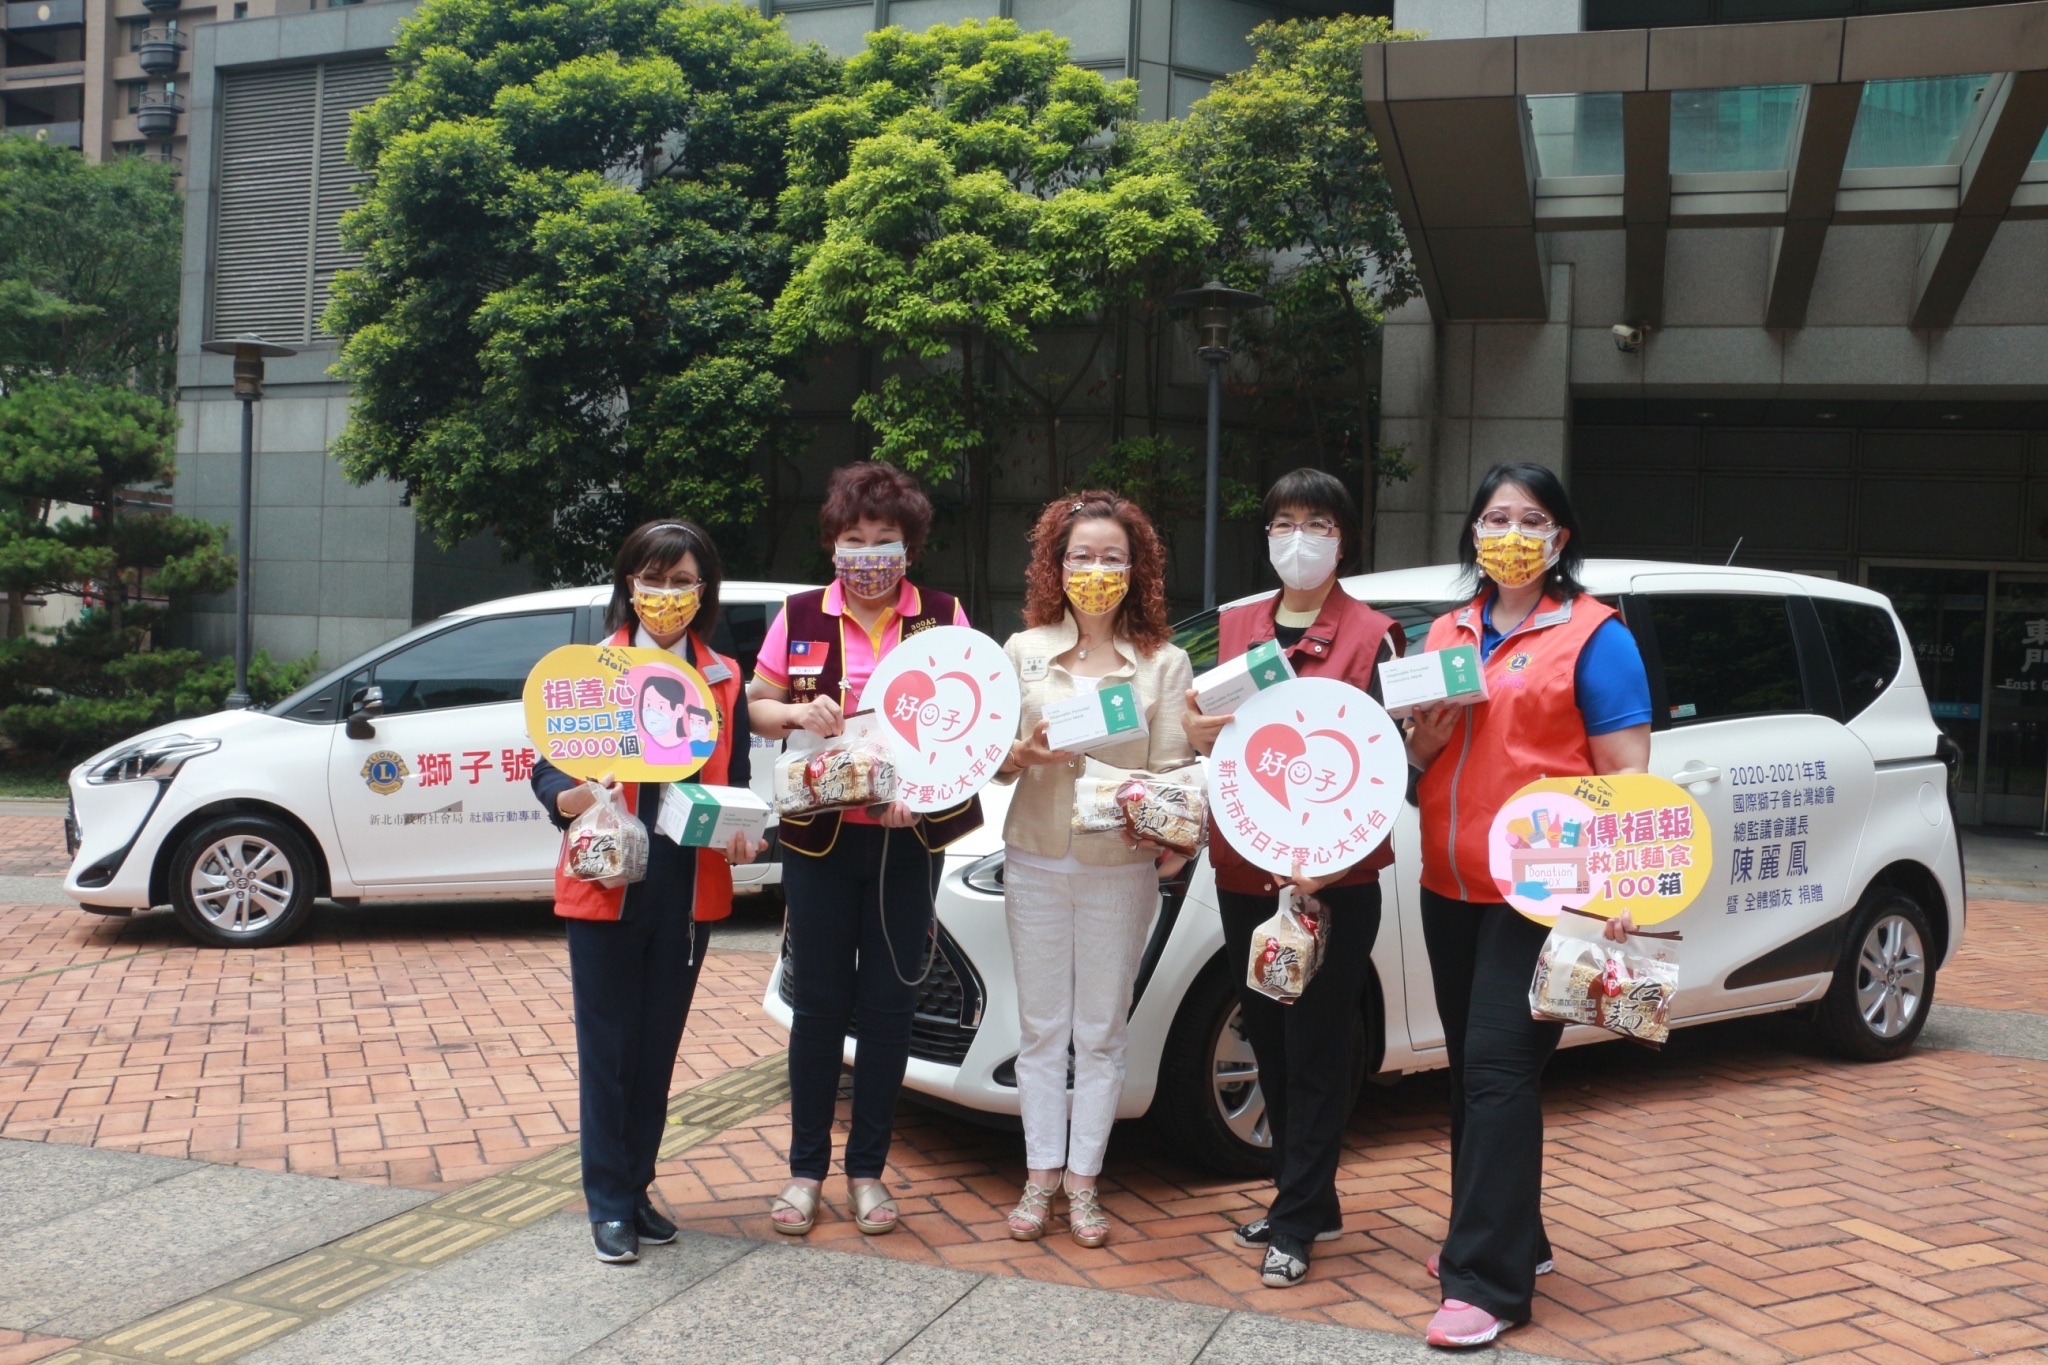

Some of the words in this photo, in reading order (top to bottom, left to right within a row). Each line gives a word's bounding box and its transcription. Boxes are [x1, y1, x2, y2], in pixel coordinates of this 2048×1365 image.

[911, 617, 937, 631] 300A2
[602, 646, 615, 657] We
[618, 655, 632, 667] Can
[1912, 642, 1955, 656] 市政府
[597, 653, 630, 676] Help
[543, 678, 637, 709] 捐善心
[2005, 678, 2036, 691] East
[547, 710, 636, 733] N95口罩
[371, 752, 398, 763] LIONS
[550, 735, 641, 759] 2000個
[379, 763, 393, 780] L
[416, 747, 536, 787] 獅子號
[1730, 760, 1827, 786] 2020-2021年度
[1573, 785, 1611, 808] Help
[1580, 777, 1594, 789] We
[1597, 785, 1613, 797] Can
[1733, 785, 1835, 813] 國際獅子會台灣總會
[369, 812, 463, 826] 新北市政府社會局
[469, 809, 542, 823] 社福行動專車
[1218, 760, 1387, 867] 新北市好日子愛心大平台
[1586, 806, 1692, 847] 傳福報
[1733, 815, 1809, 843] 總監議會議長
[1529, 863, 1573, 877] Donation
[1588, 844, 1691, 874] 救飢麵食
[1730, 840, 1808, 885] 陳麗鳳
[1603, 872, 1682, 900] 100箱
[1726, 895, 1739, 914] 暨
[1744, 888, 1793, 912] 全體獅友
[1798, 884, 1823, 905] 捐贈
